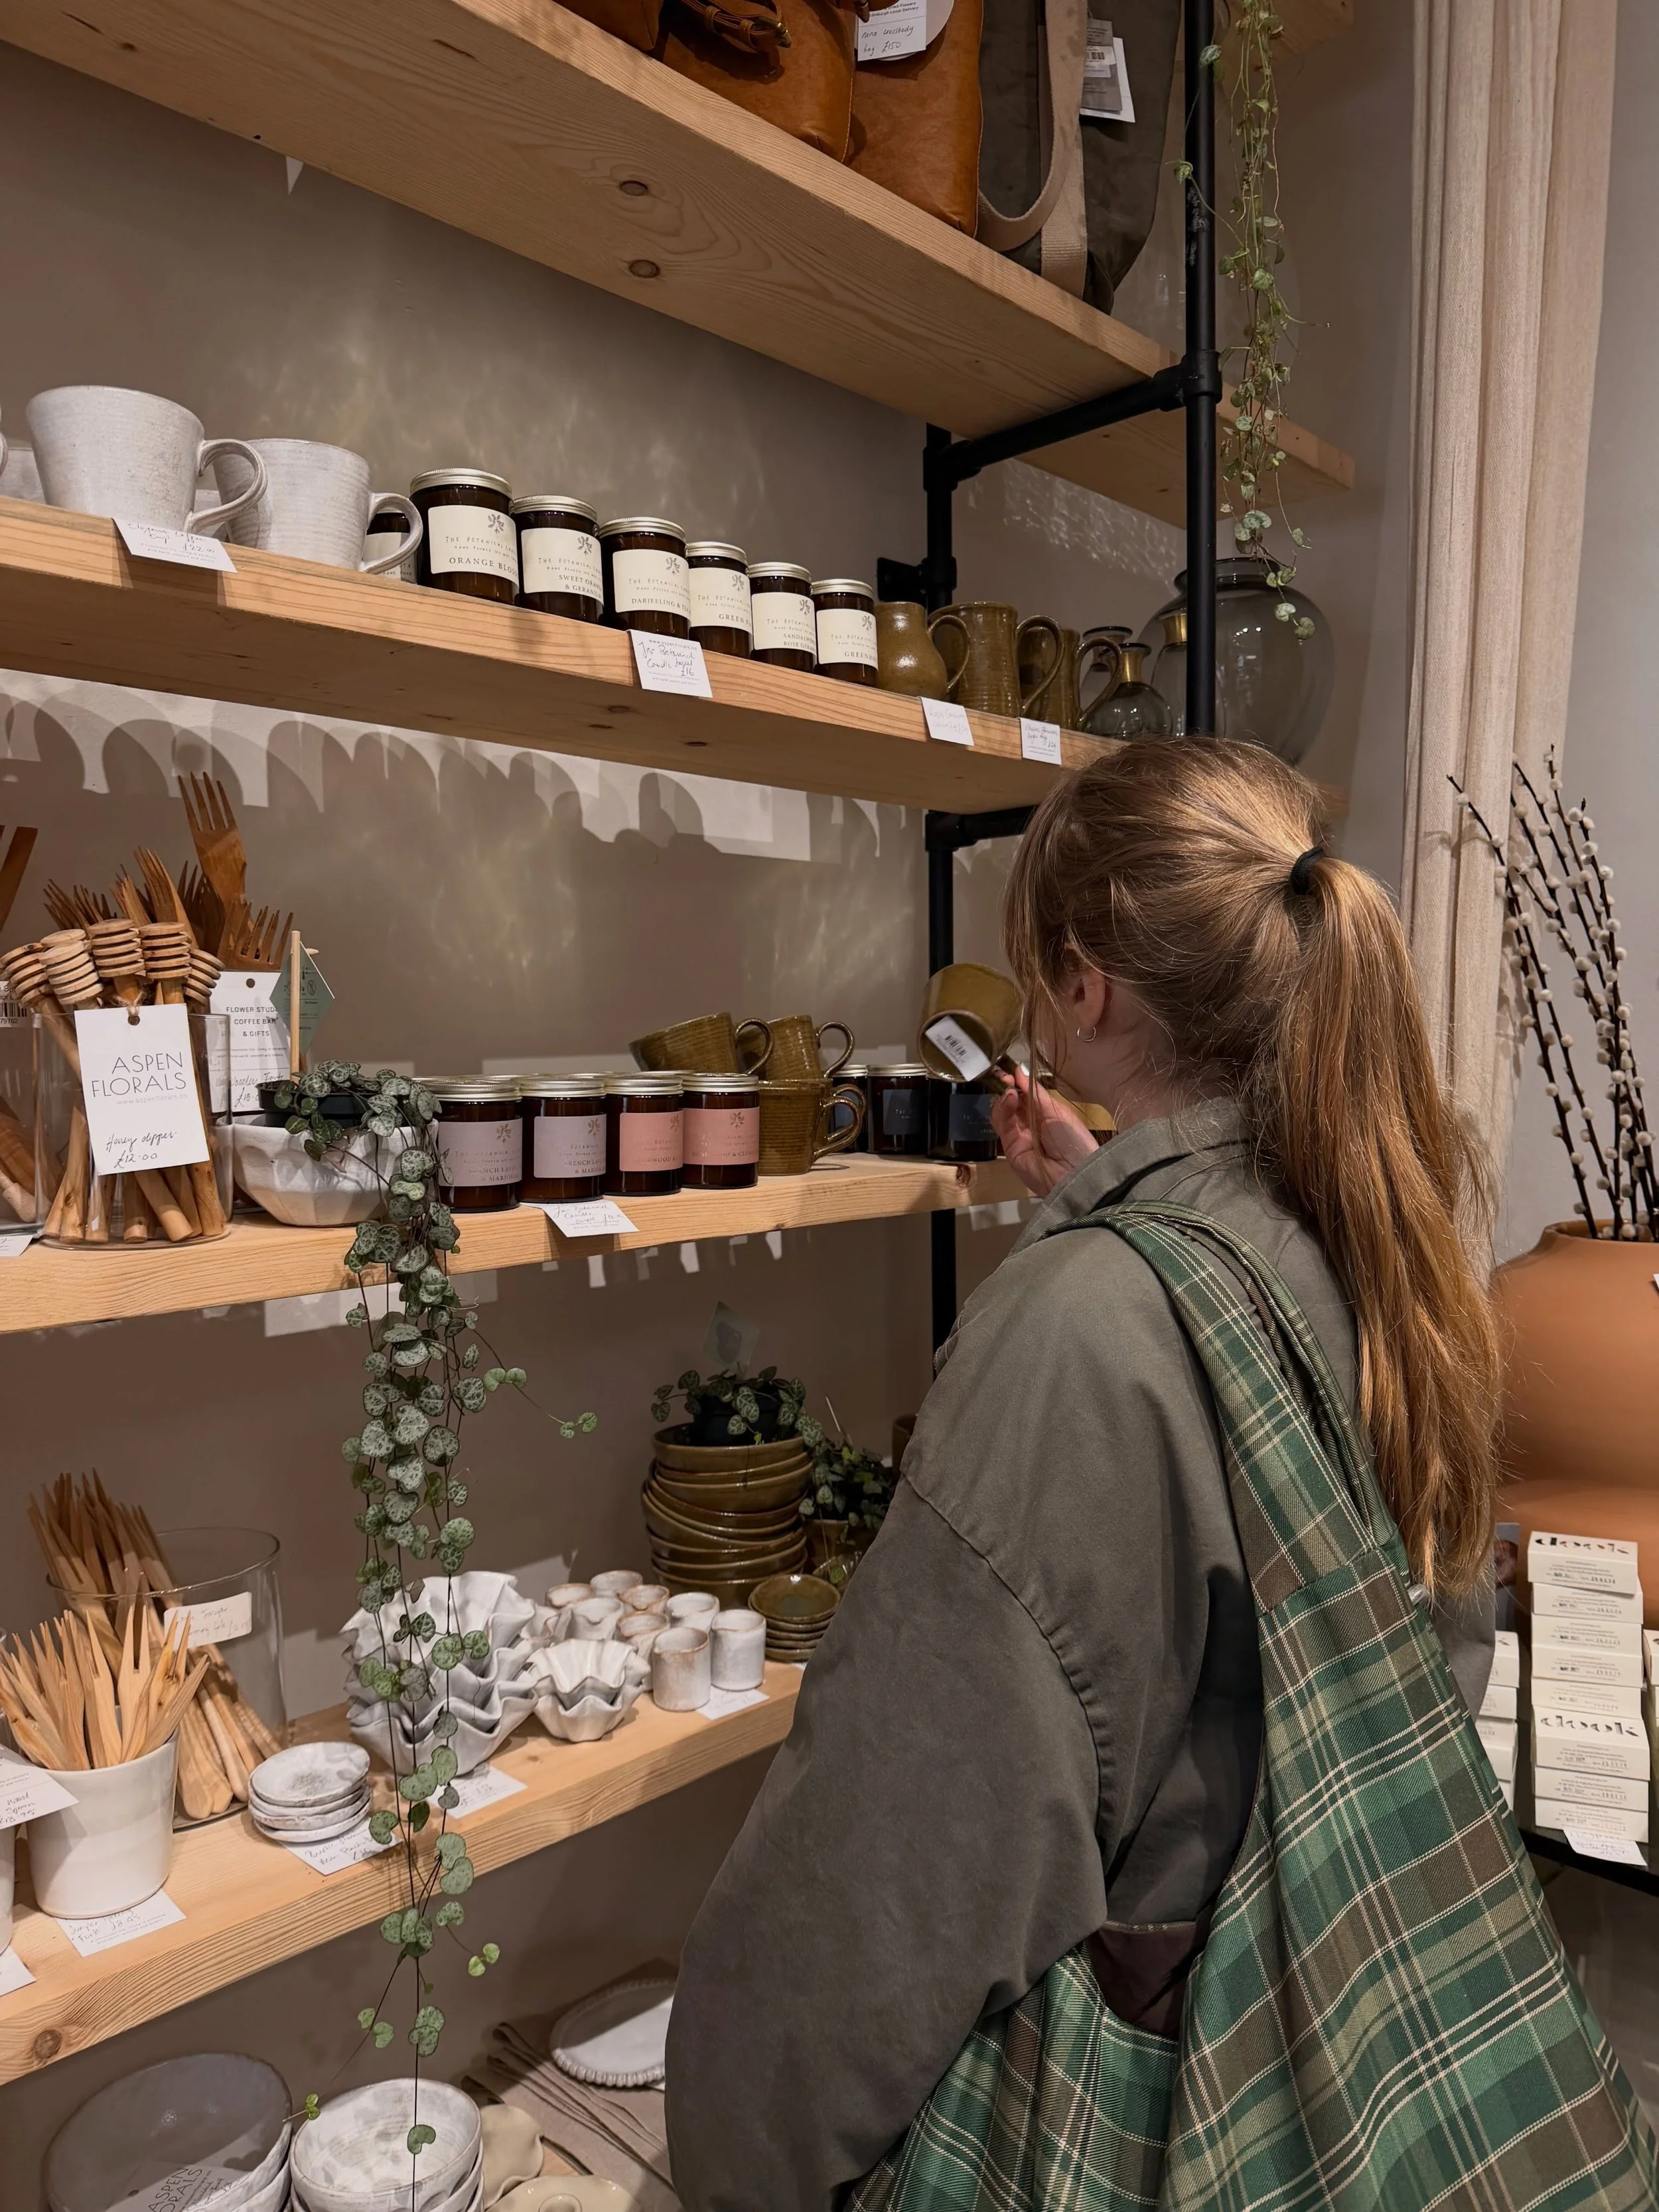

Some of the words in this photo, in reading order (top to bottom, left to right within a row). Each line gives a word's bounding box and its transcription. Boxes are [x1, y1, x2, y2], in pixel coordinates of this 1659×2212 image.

[467, 536, 503, 549] BOTANICAL
[449, 557, 494, 568] ORANGE
[559, 575, 584, 583] SWEET
[631, 597, 676, 607] DARJEELING
[719, 613, 745, 623] GREEN
[111, 1052, 182, 1074] ASPEN
[92, 1072, 186, 1098] FLORALS
[117, 1094, 188, 1105] www.aspenflorals.co
[106, 1133, 138, 1153] Honey
[141, 1130, 178, 1147] dipper
